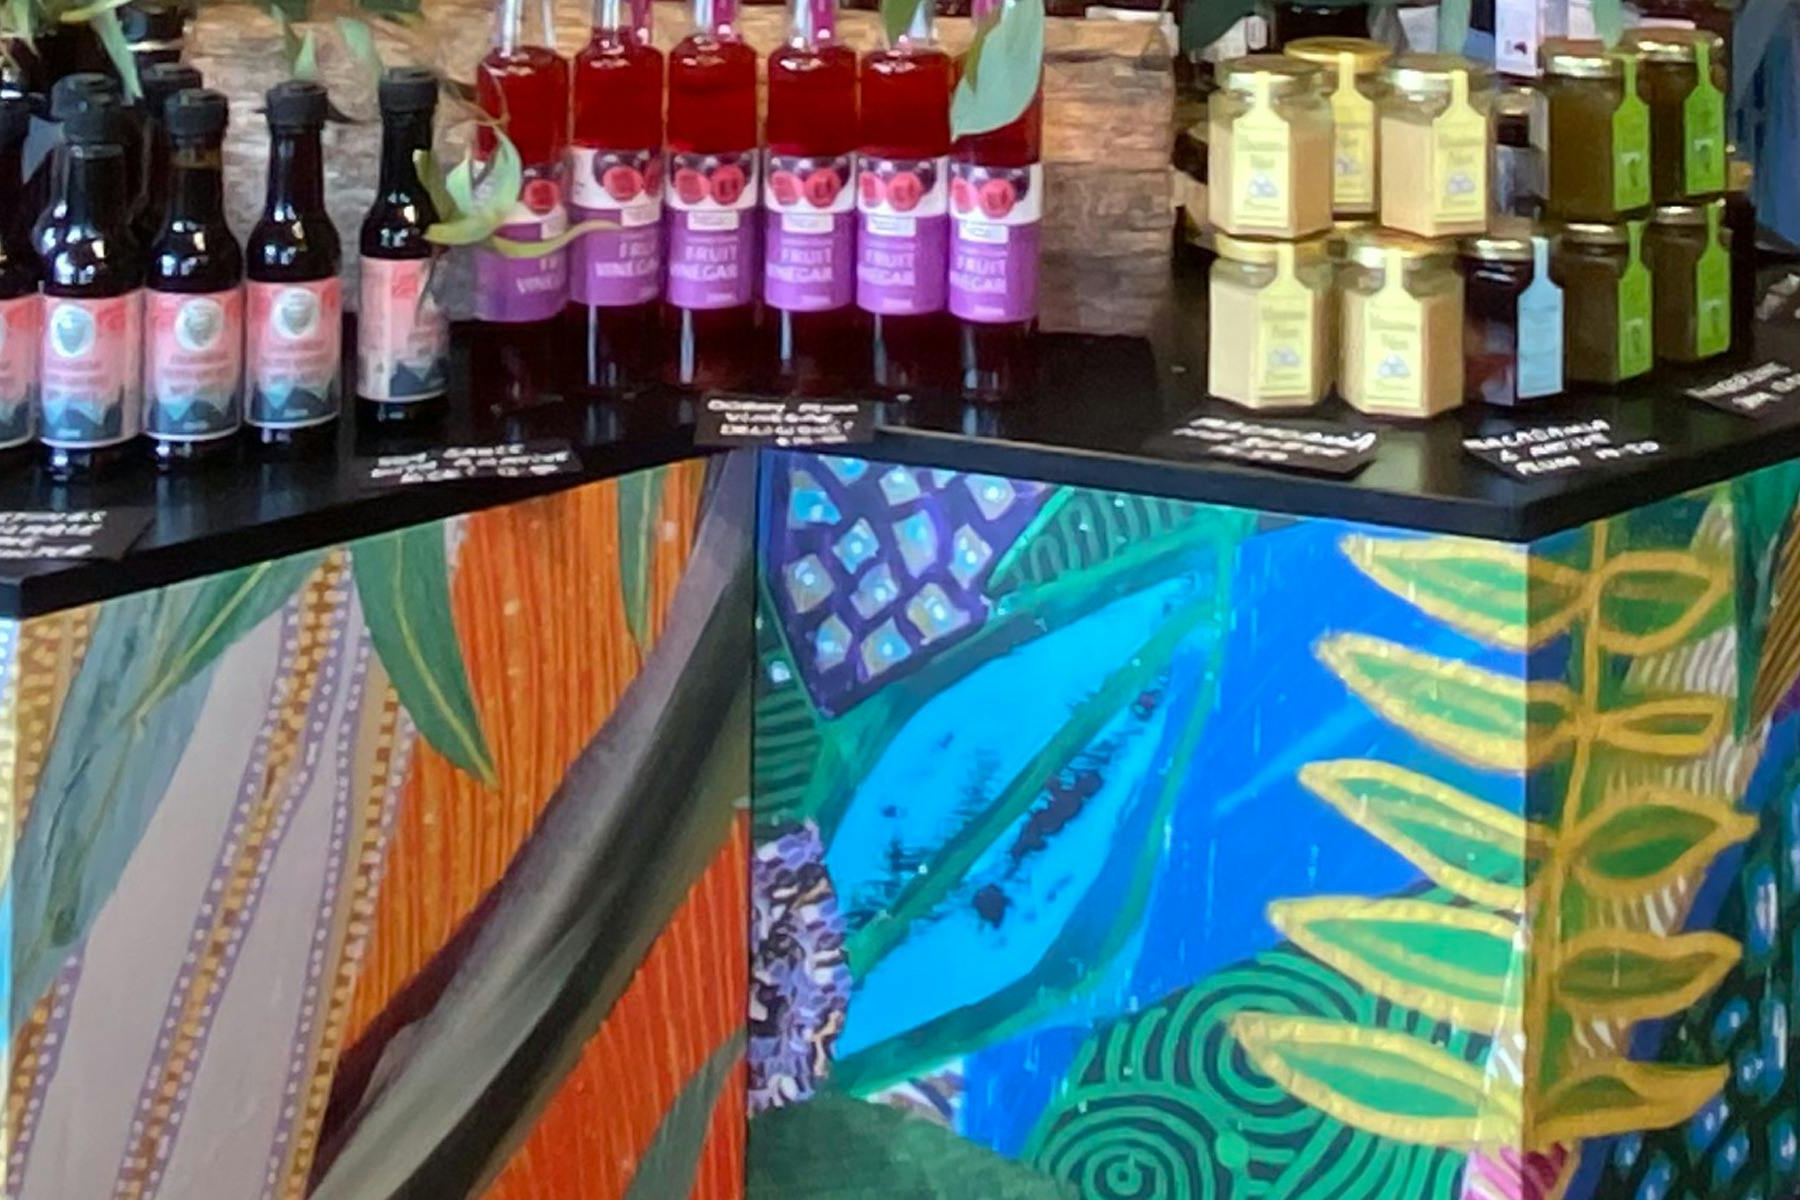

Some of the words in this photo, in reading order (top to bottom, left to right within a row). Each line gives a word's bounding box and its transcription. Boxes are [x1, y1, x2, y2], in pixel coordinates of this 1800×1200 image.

[684, 244, 738, 262] FRUIT
[780, 247, 833, 265] FRUIT
[864, 249, 916, 270] FRUIT
[956, 255, 1007, 277] FRUIT
[1461, 418, 1611, 450] MACADAMIA
[1514, 455, 1582, 476] PLUM
